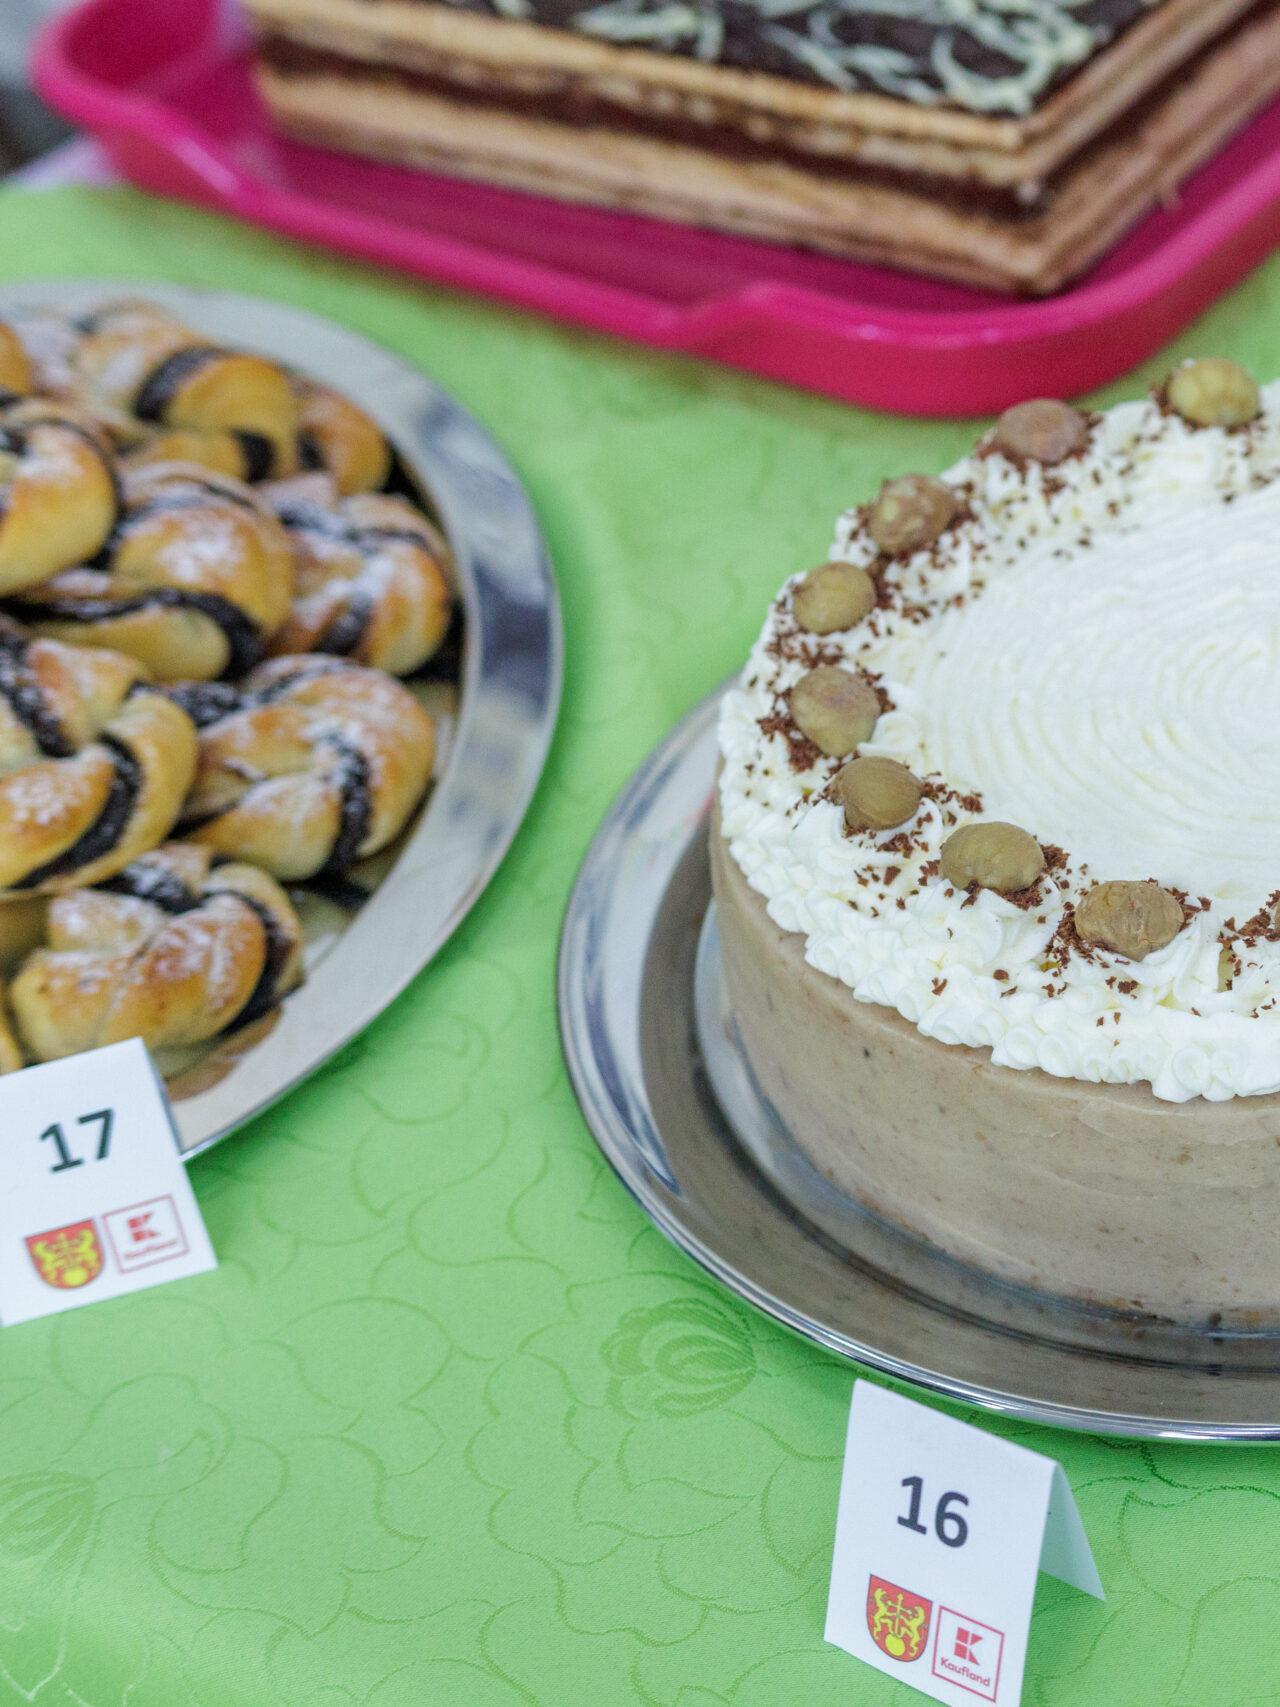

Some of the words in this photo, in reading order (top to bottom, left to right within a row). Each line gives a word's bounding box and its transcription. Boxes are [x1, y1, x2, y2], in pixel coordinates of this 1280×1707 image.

[40, 1107, 114, 1173] 17
[897, 1475, 970, 1548] 16
[940, 1656, 991, 1687] Kaufland
[953, 1626, 984, 1666] K
